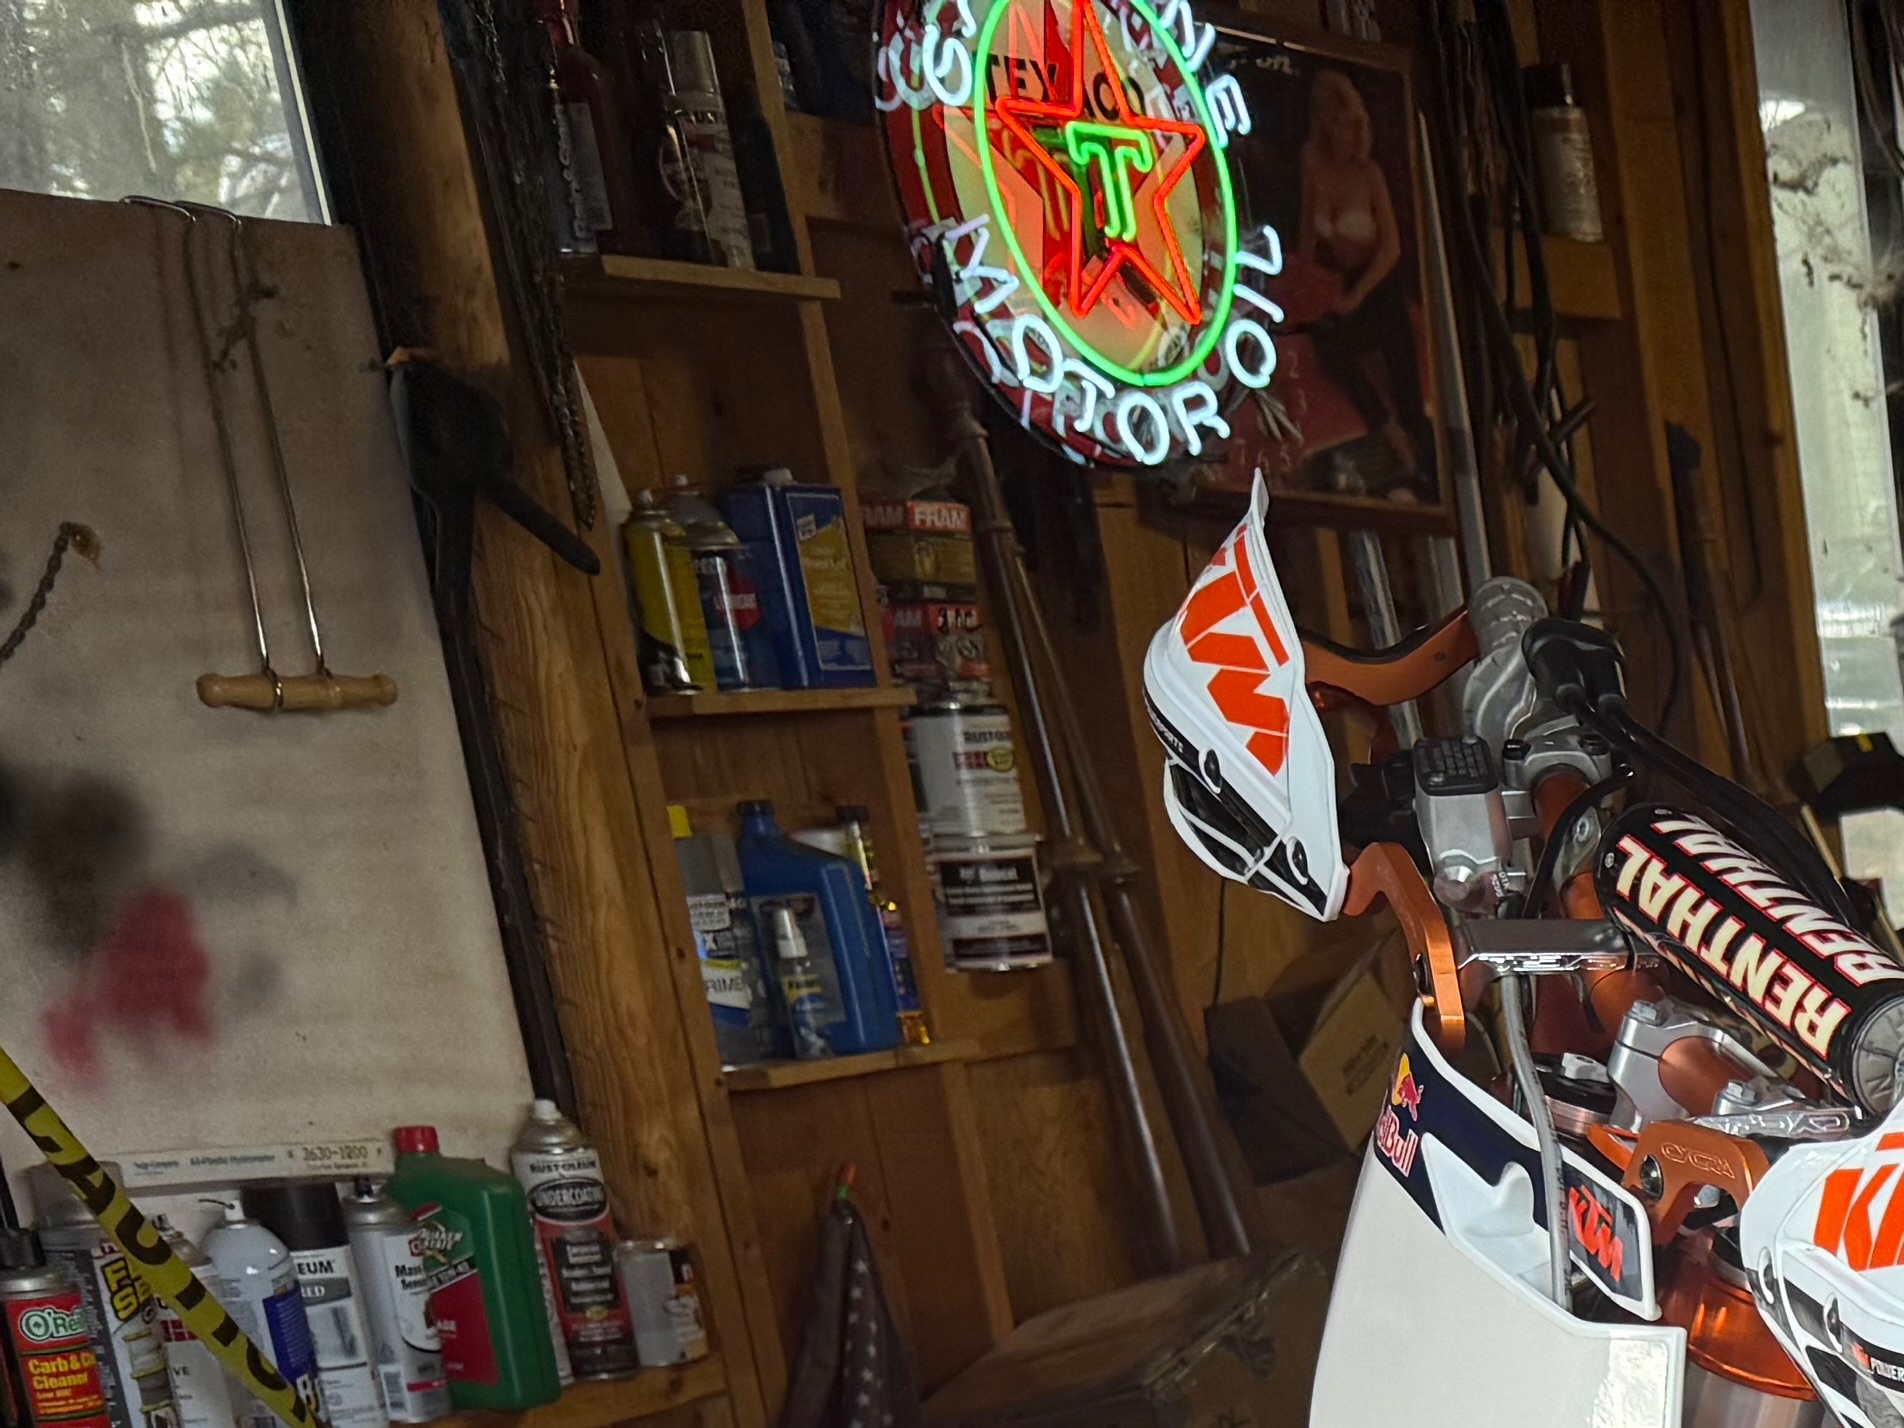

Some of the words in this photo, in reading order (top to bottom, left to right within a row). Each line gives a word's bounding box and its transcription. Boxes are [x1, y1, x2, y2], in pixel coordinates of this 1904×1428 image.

[913, 507, 968, 530] FRAM
[1615, 833, 1853, 1061] RENTHAL
[1568, 1184, 1624, 1284] KTM
[29, 1355, 67, 1375] Carb
